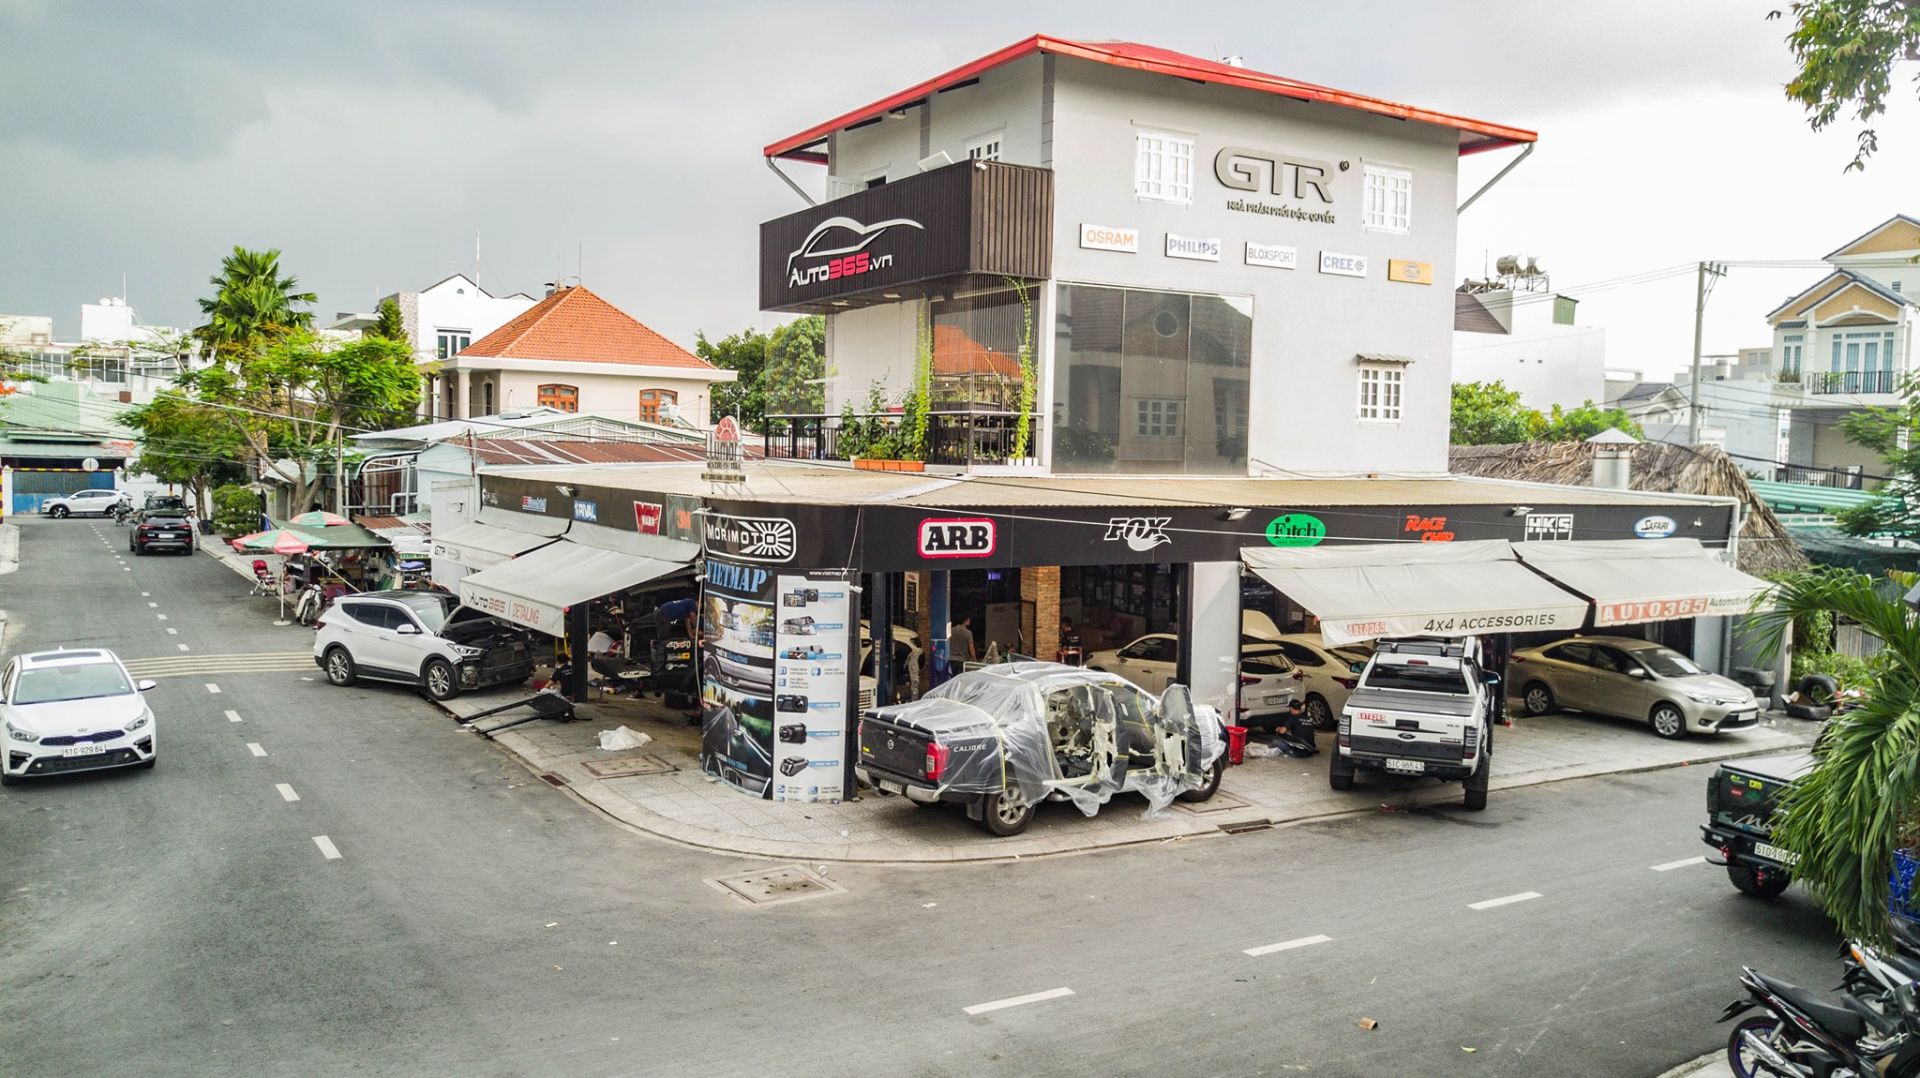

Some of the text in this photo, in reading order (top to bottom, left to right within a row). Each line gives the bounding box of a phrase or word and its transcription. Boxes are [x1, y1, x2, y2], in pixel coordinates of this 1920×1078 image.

[1215, 147, 1334, 203] GTR
[1086, 229, 1134, 246] OSRAM
[1169, 238, 1218, 256] PHILIPS
[1248, 247, 1294, 263] BLOXSPORT
[1323, 256, 1354, 271] CREE
[1273, 516, 1317, 538] Fitch
[1405, 515, 1446, 531] RACE
[1527, 516, 1571, 534] HKS
[1641, 519, 1669, 531] SAFARI
[925, 525, 989, 551] ARB
[1104, 516, 1172, 551] FOX
[706, 560, 767, 593] VIETMAP
[1601, 597, 1708, 623] AUTO365
[1459, 613, 1556, 630] ACCESSORIES
[953, 743, 987, 753] CALIBRE
